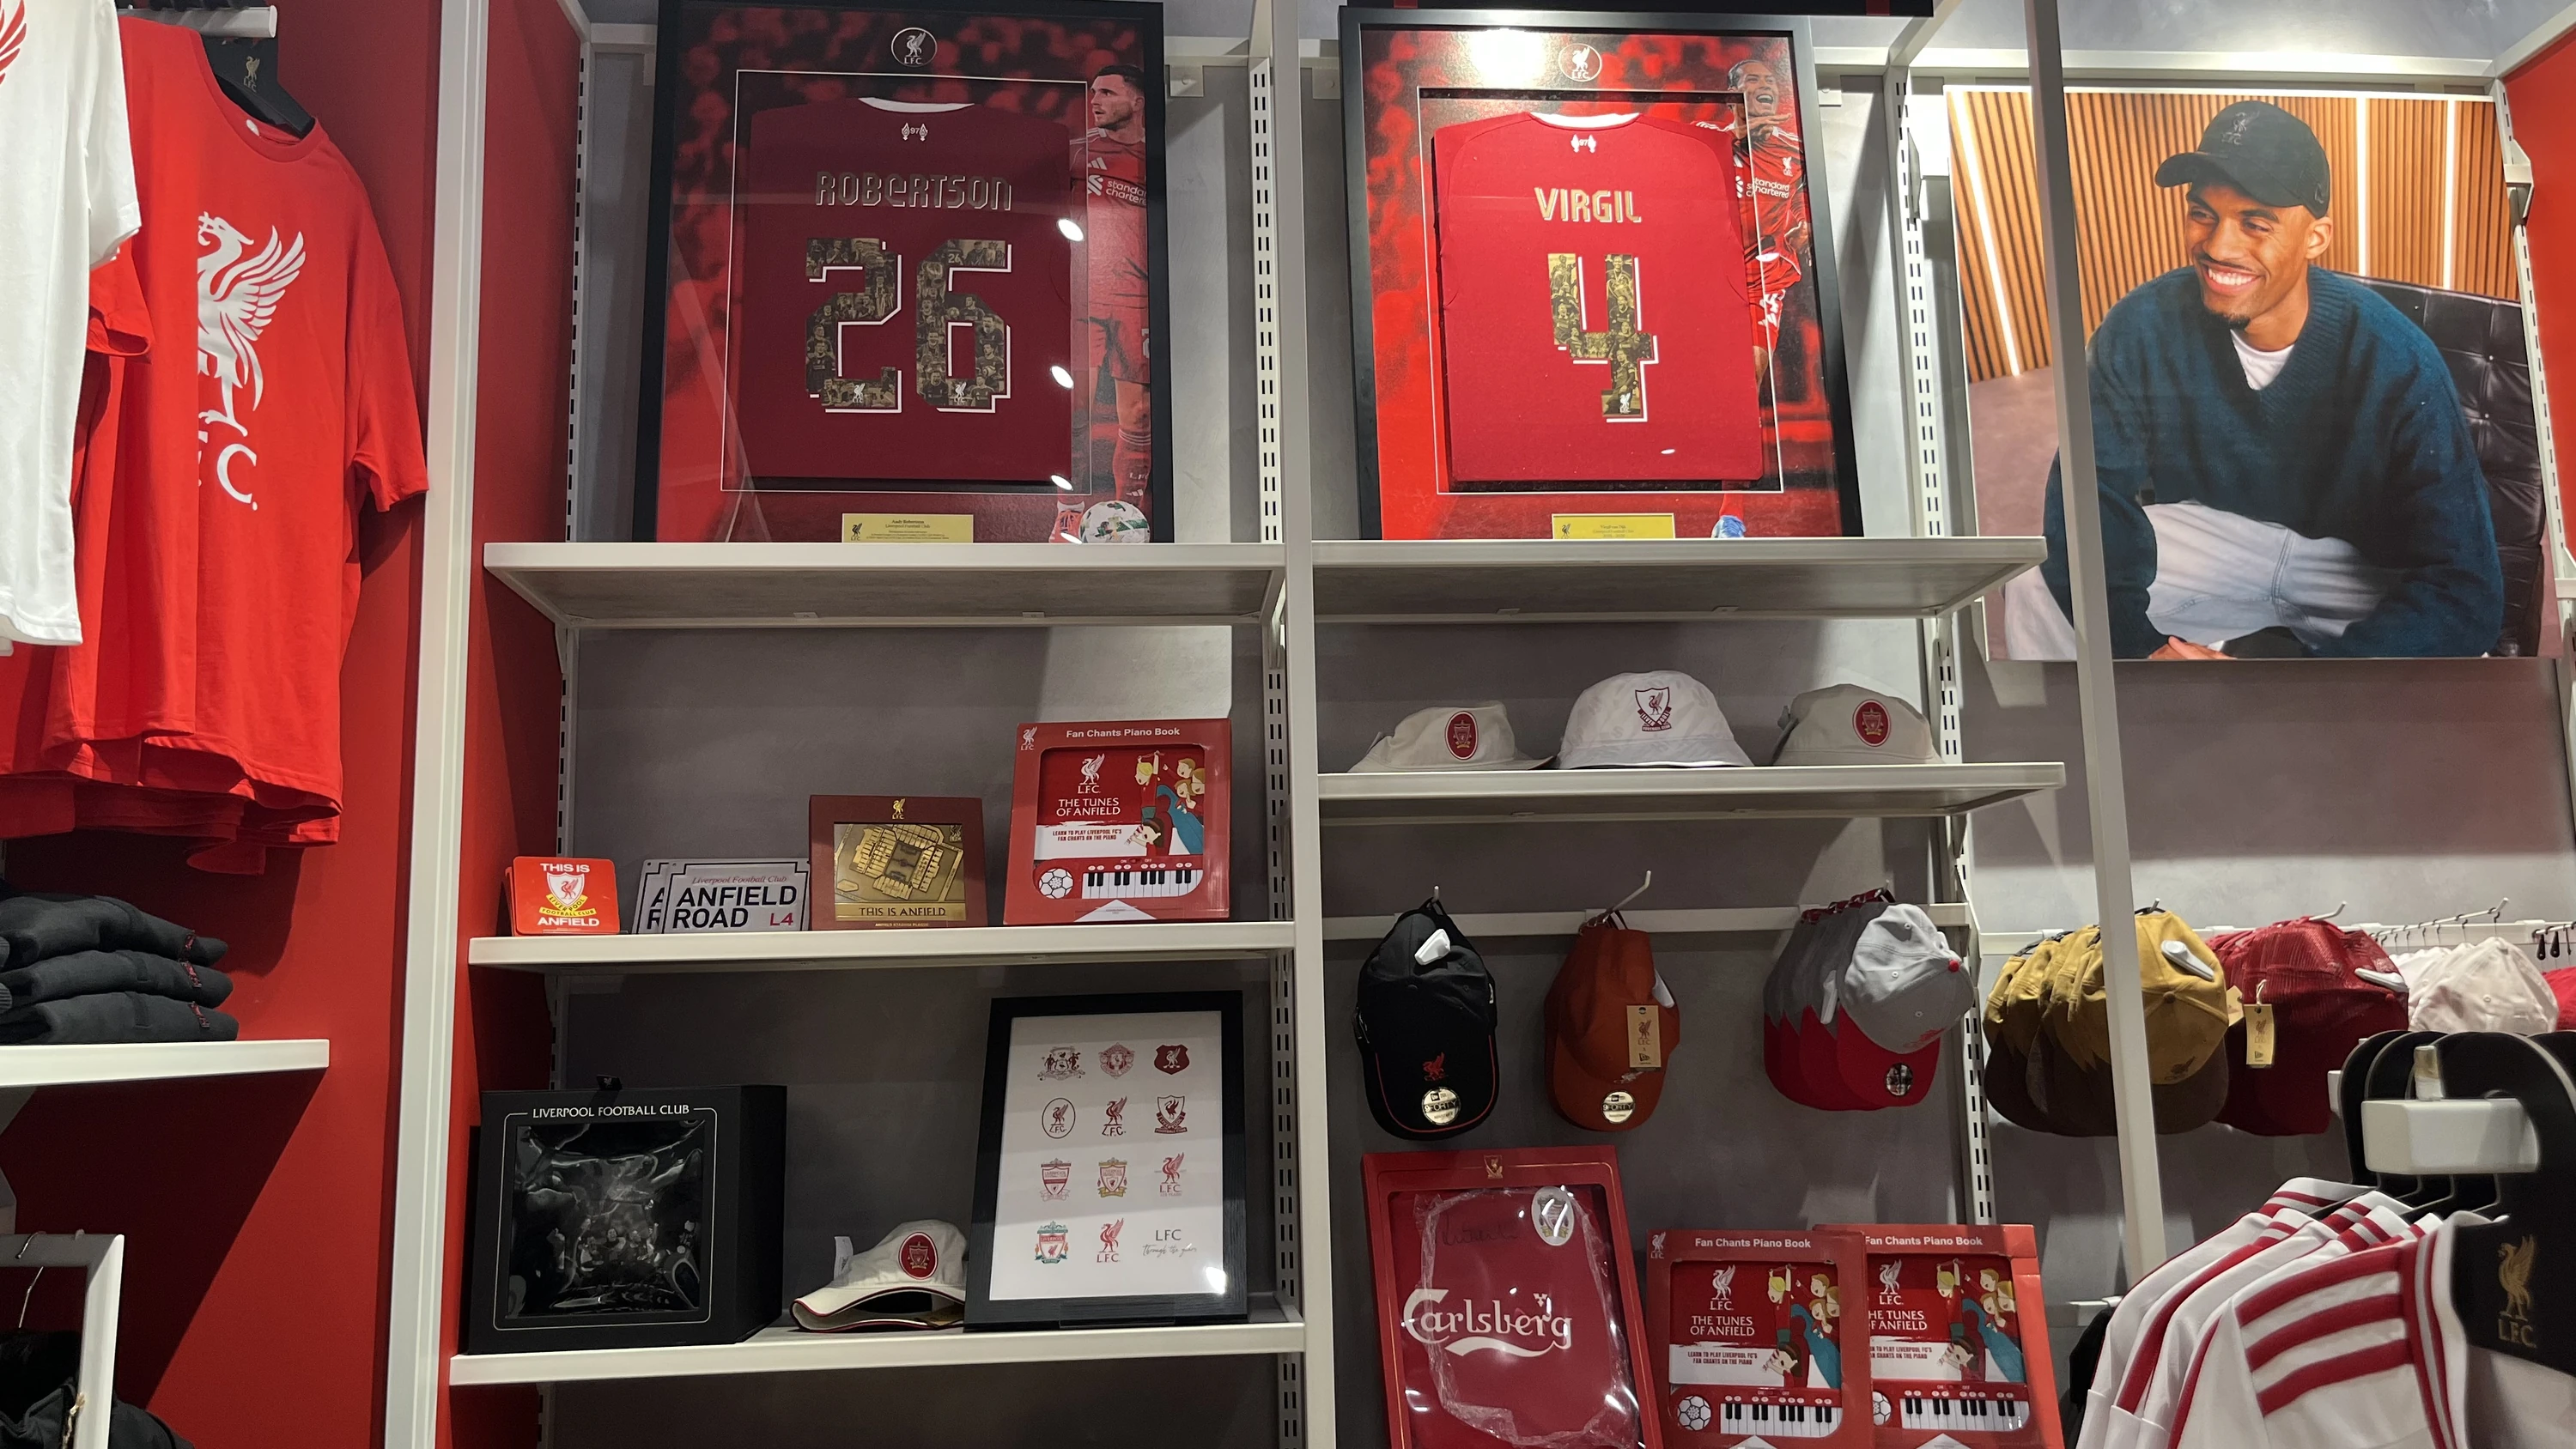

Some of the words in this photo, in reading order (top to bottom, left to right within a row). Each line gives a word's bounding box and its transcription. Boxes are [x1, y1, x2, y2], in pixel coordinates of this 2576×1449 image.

[816, 172, 1012, 211] ROBERTSON
[1107, 180, 1147, 197] standar
[1106, 188, 1147, 206] chartere
[1534, 187, 1642, 223] VIRGIL
[805, 238, 1012, 414] 26
[1548, 253, 1659, 423] 4
[1066, 730, 1084, 738] Fan
[1086, 729, 1121, 737] Chants
[1124, 728, 1152, 737] Piano
[1154, 727, 1181, 736] Book
[1058, 798, 1080, 808] THE
[1082, 797, 1120, 807] TUNES
[1056, 808, 1072, 816] OF
[1072, 806, 1121, 816] ANFIELD
[540, 863, 574, 872] THIS
[576, 864, 590, 873] IS
[692, 876, 731, 885] Liverpool
[676, 886, 798, 907] ANFIELD
[549, 896, 585, 912] LIVERPOOL
[859, 907, 884, 917] THIS
[888, 907, 896, 917] IS
[900, 906, 946, 917] ANFIELD
[538, 917, 600, 926] ANFIELD
[672, 907, 749, 929] ROAD
[769, 912, 794, 926] L4
[532, 1106, 594, 1118] LIVERPOOL
[598, 1106, 657, 1117] FOOTBALL
[659, 1104, 690, 1115] CLUB
[1155, 1228, 1182, 1241] LFC
[1865, 1236, 1883, 1245] Fan
[1885, 1235, 1921, 1245] Chants
[1923, 1236, 1953, 1245] Piano
[1955, 1236, 1984, 1246] Book
[1695, 1238, 1713, 1246] Fan
[1716, 1238, 1751, 1247] Chants
[1753, 1239, 1782, 1247] Piano
[1784, 1239, 1811, 1248] Book
[1403, 1288, 1572, 1349] Carlsberg
[1692, 1315, 1713, 1325] THE
[1716, 1316, 1753, 1326] TUNES
[1868, 1310, 1883, 1319] HE
[1886, 1310, 1924, 1320] TUNES
[1690, 1325, 1705, 1336] OF
[1707, 1325, 1755, 1337] ANFIELD
[1869, 1320, 1877, 1330] F
[1879, 1320, 1928, 1331] ANFIELD
